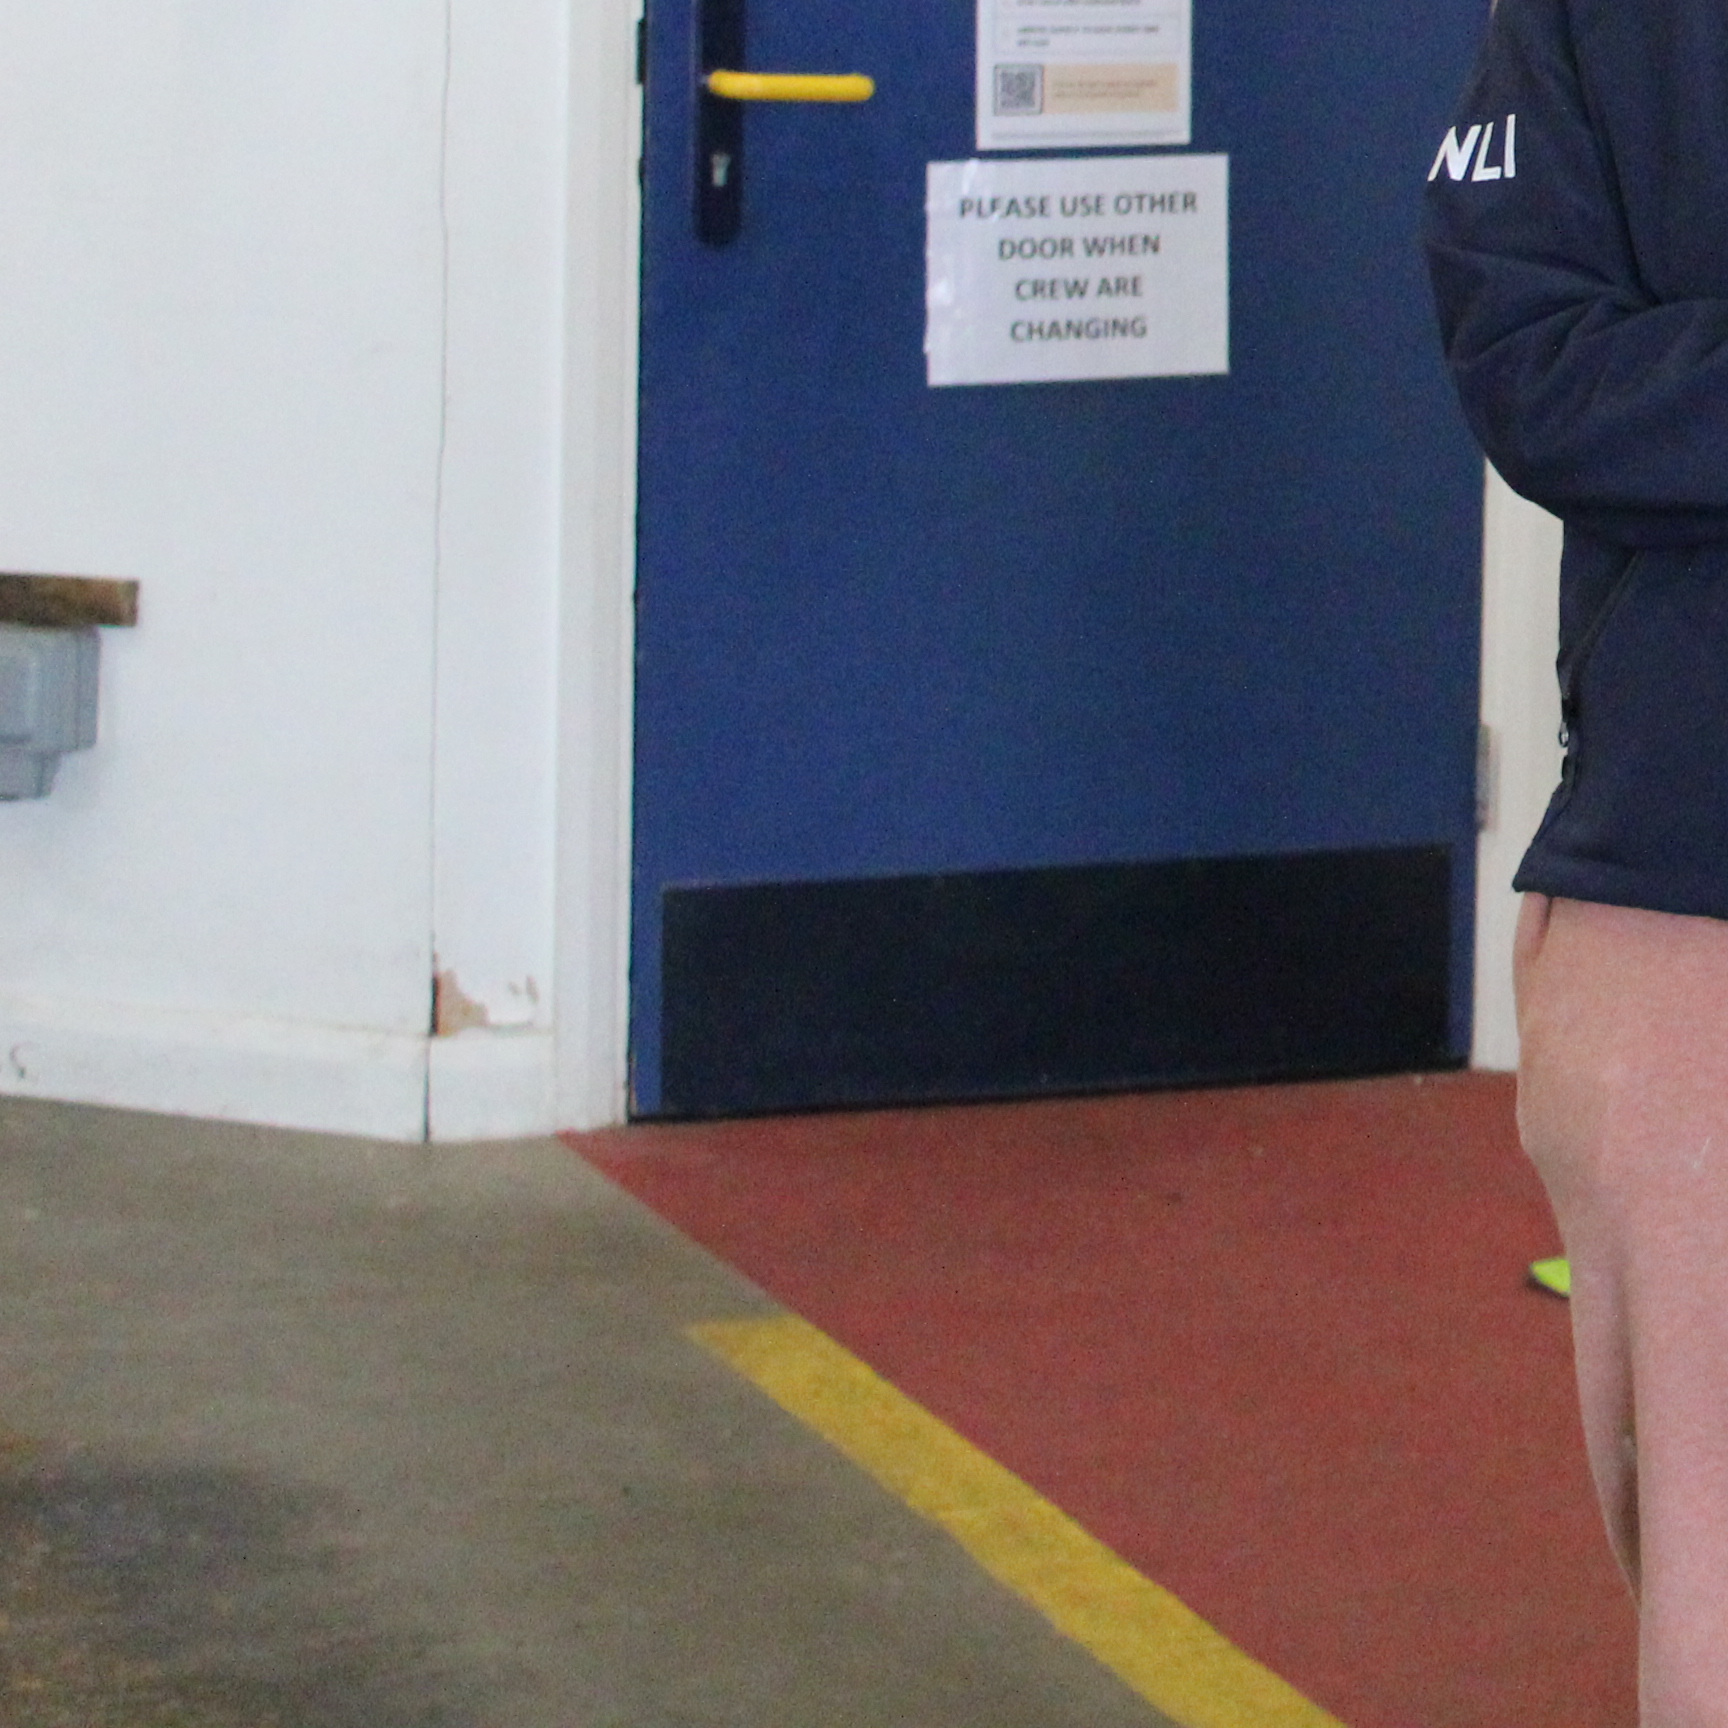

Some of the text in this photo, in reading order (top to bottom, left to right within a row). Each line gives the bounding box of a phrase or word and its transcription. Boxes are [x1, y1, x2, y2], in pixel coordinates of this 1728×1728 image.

[1427, 113, 1517, 182] NLI
[959, 191, 1198, 219] PLEASE USE OTHER
[998, 234, 1161, 260] DOOR WHEN
[1014, 275, 1143, 302] CREW ARE
[1009, 316, 1148, 343] CHANGING
